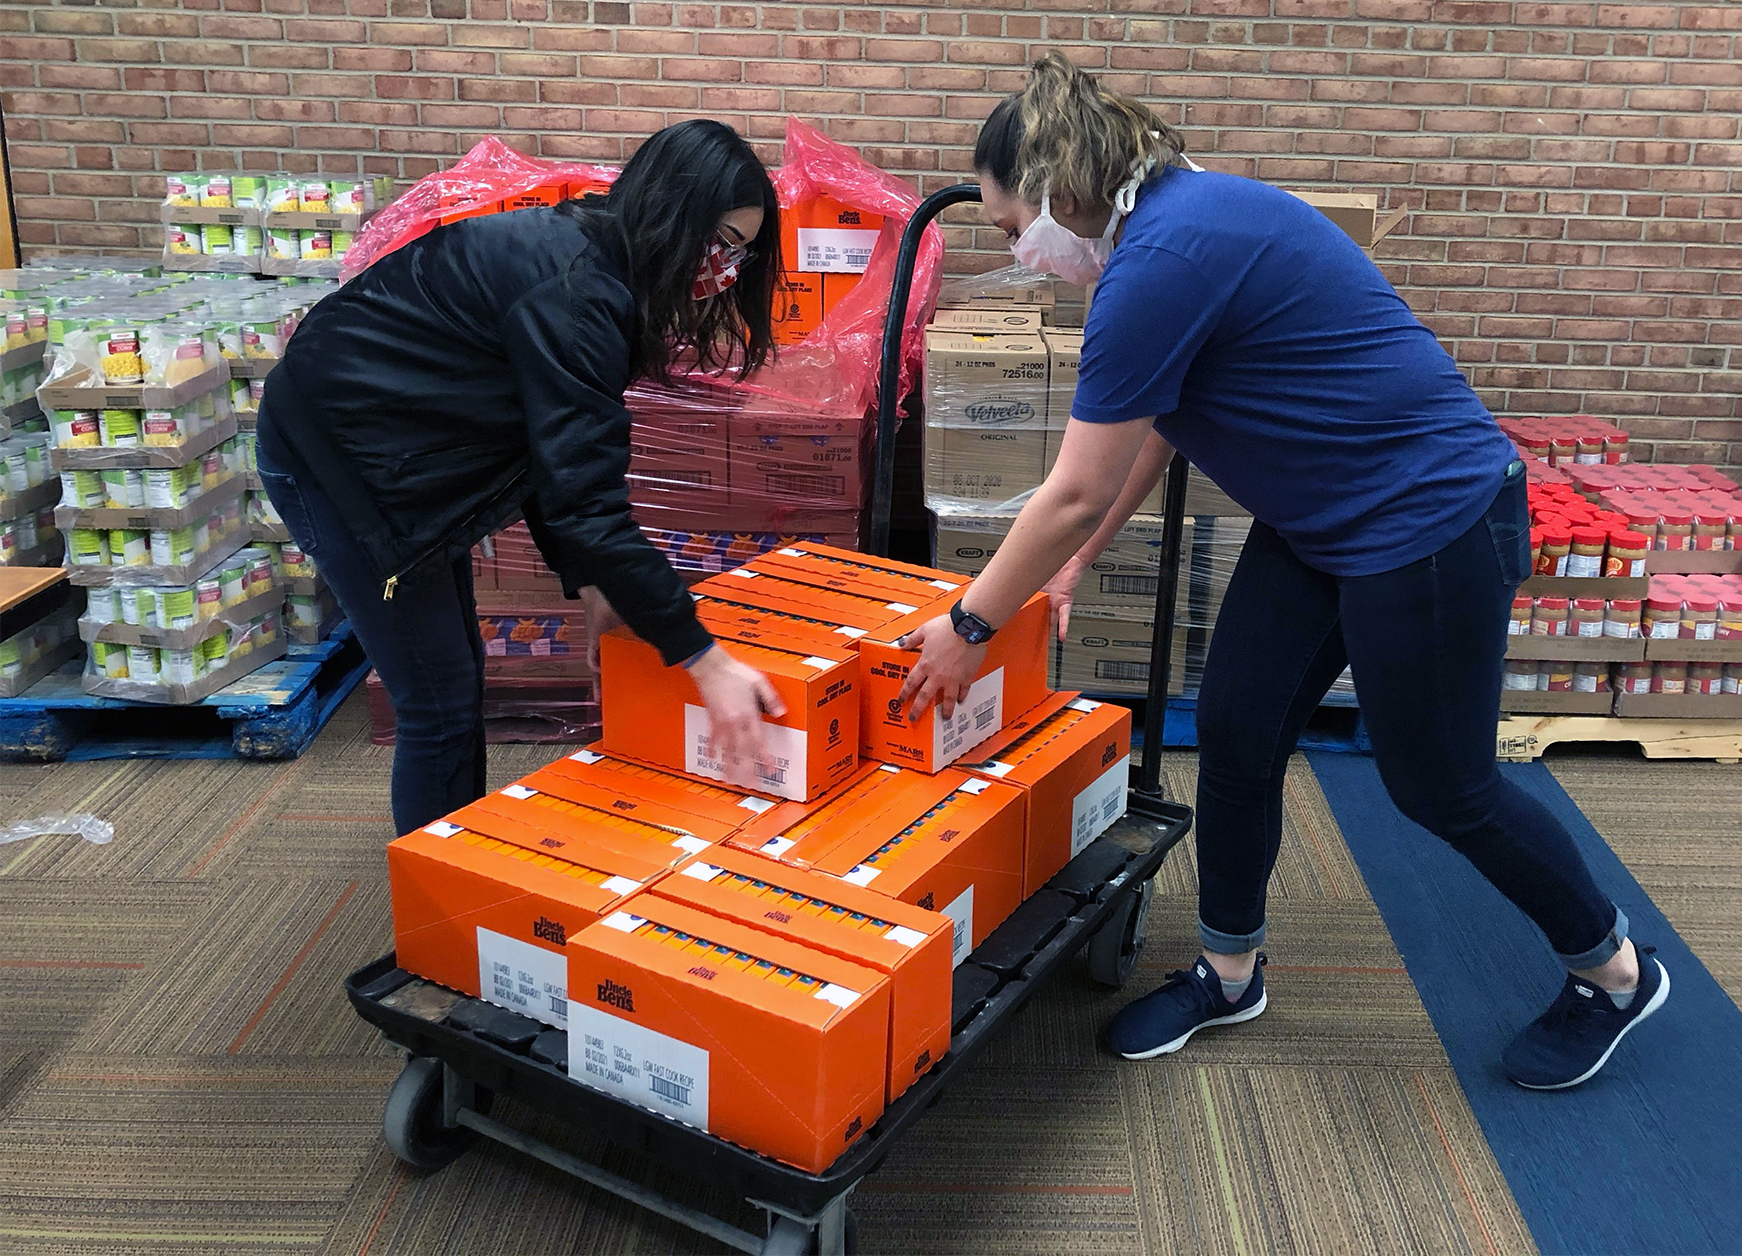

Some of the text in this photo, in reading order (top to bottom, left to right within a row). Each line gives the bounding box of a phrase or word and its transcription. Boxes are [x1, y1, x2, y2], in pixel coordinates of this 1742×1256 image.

[971, 402, 1030, 422] Velveeta
[870, 667, 886, 677] COOL
[888, 671, 900, 679] DRY
[882, 661, 901, 672] STORE
[540, 916, 565, 933] Uncle
[494, 986, 528, 1006] MADE IN CANADA
[606, 978, 632, 998] Uncle
[585, 1048, 591, 1060] BB
[586, 1062, 624, 1085] MADE IN CANADA
[654, 1064, 665, 1076] FAST
[666, 1068, 679, 1082] COOK
[680, 1073, 694, 1089] RECIPE
